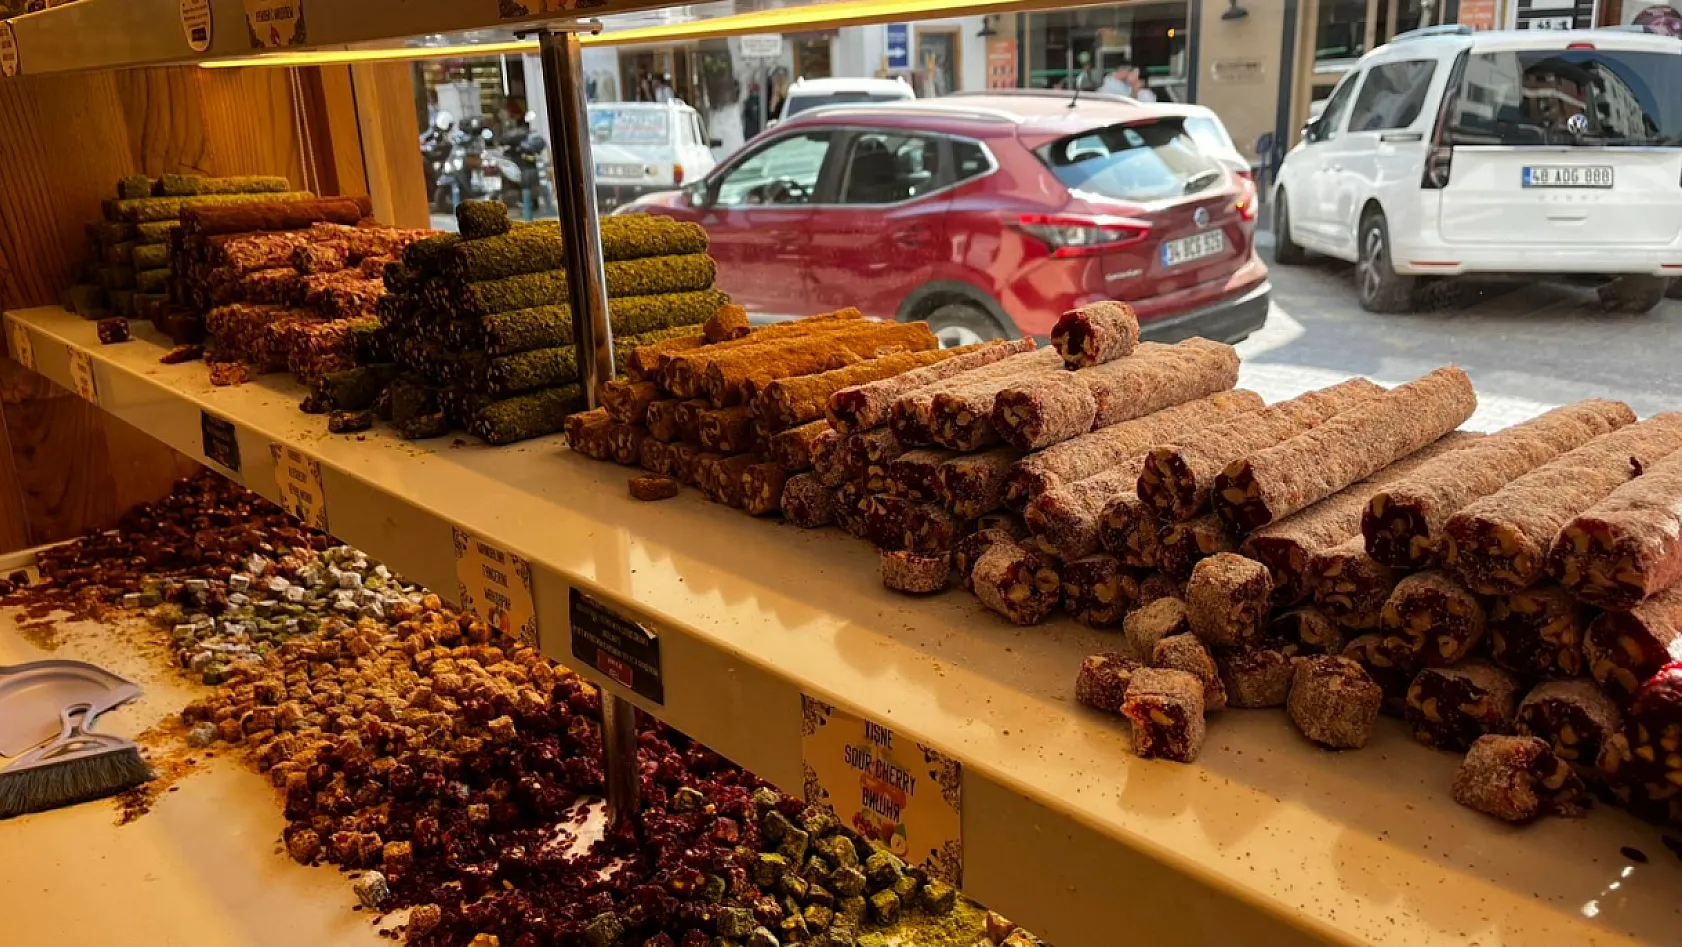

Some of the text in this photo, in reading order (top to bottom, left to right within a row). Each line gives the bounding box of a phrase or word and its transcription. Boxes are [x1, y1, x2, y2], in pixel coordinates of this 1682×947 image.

[1532, 168, 1549, 184] 48
[1555, 168, 1579, 184] ADG
[844, 744, 916, 796] SOUR CHERRY
[861, 786, 900, 823] ВИШНЯ
